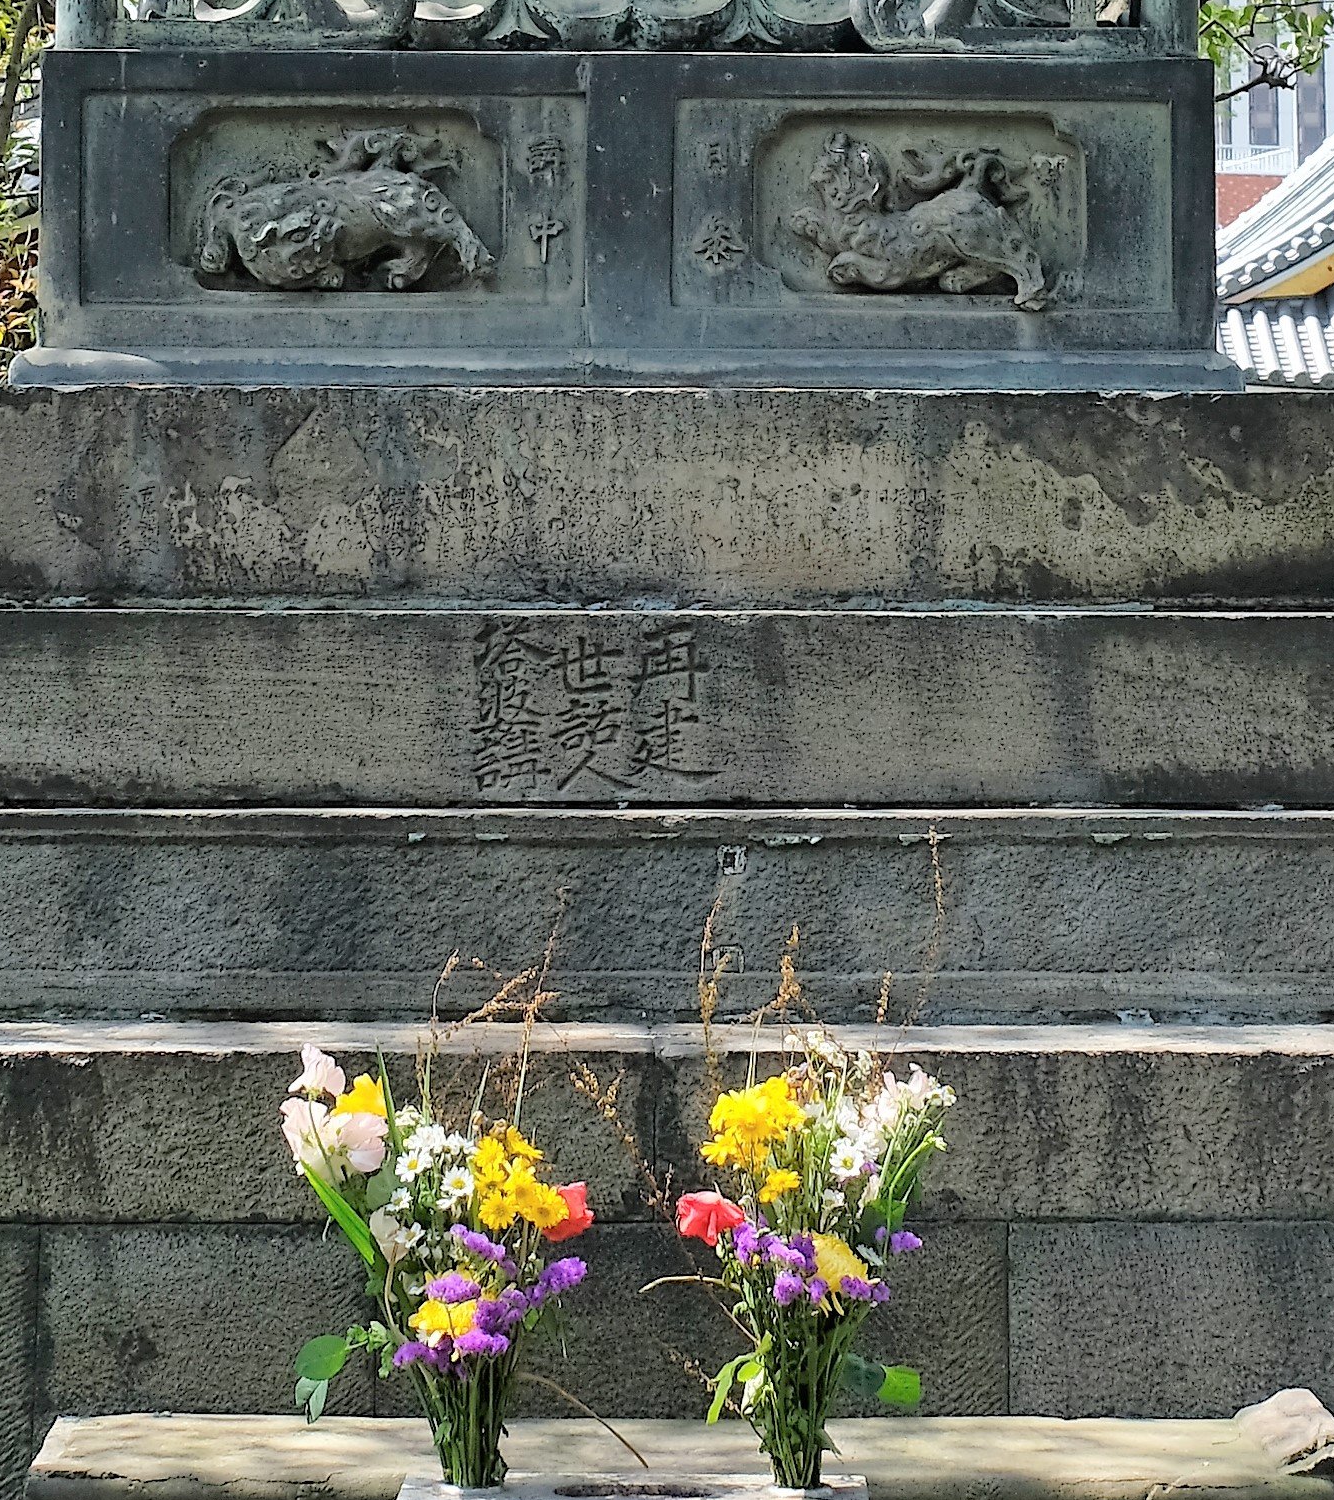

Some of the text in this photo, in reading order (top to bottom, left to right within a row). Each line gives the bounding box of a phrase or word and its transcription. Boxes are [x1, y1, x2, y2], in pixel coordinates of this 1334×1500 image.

[549, 636, 641, 790] 世話人
[624, 620, 723, 779] 再建
